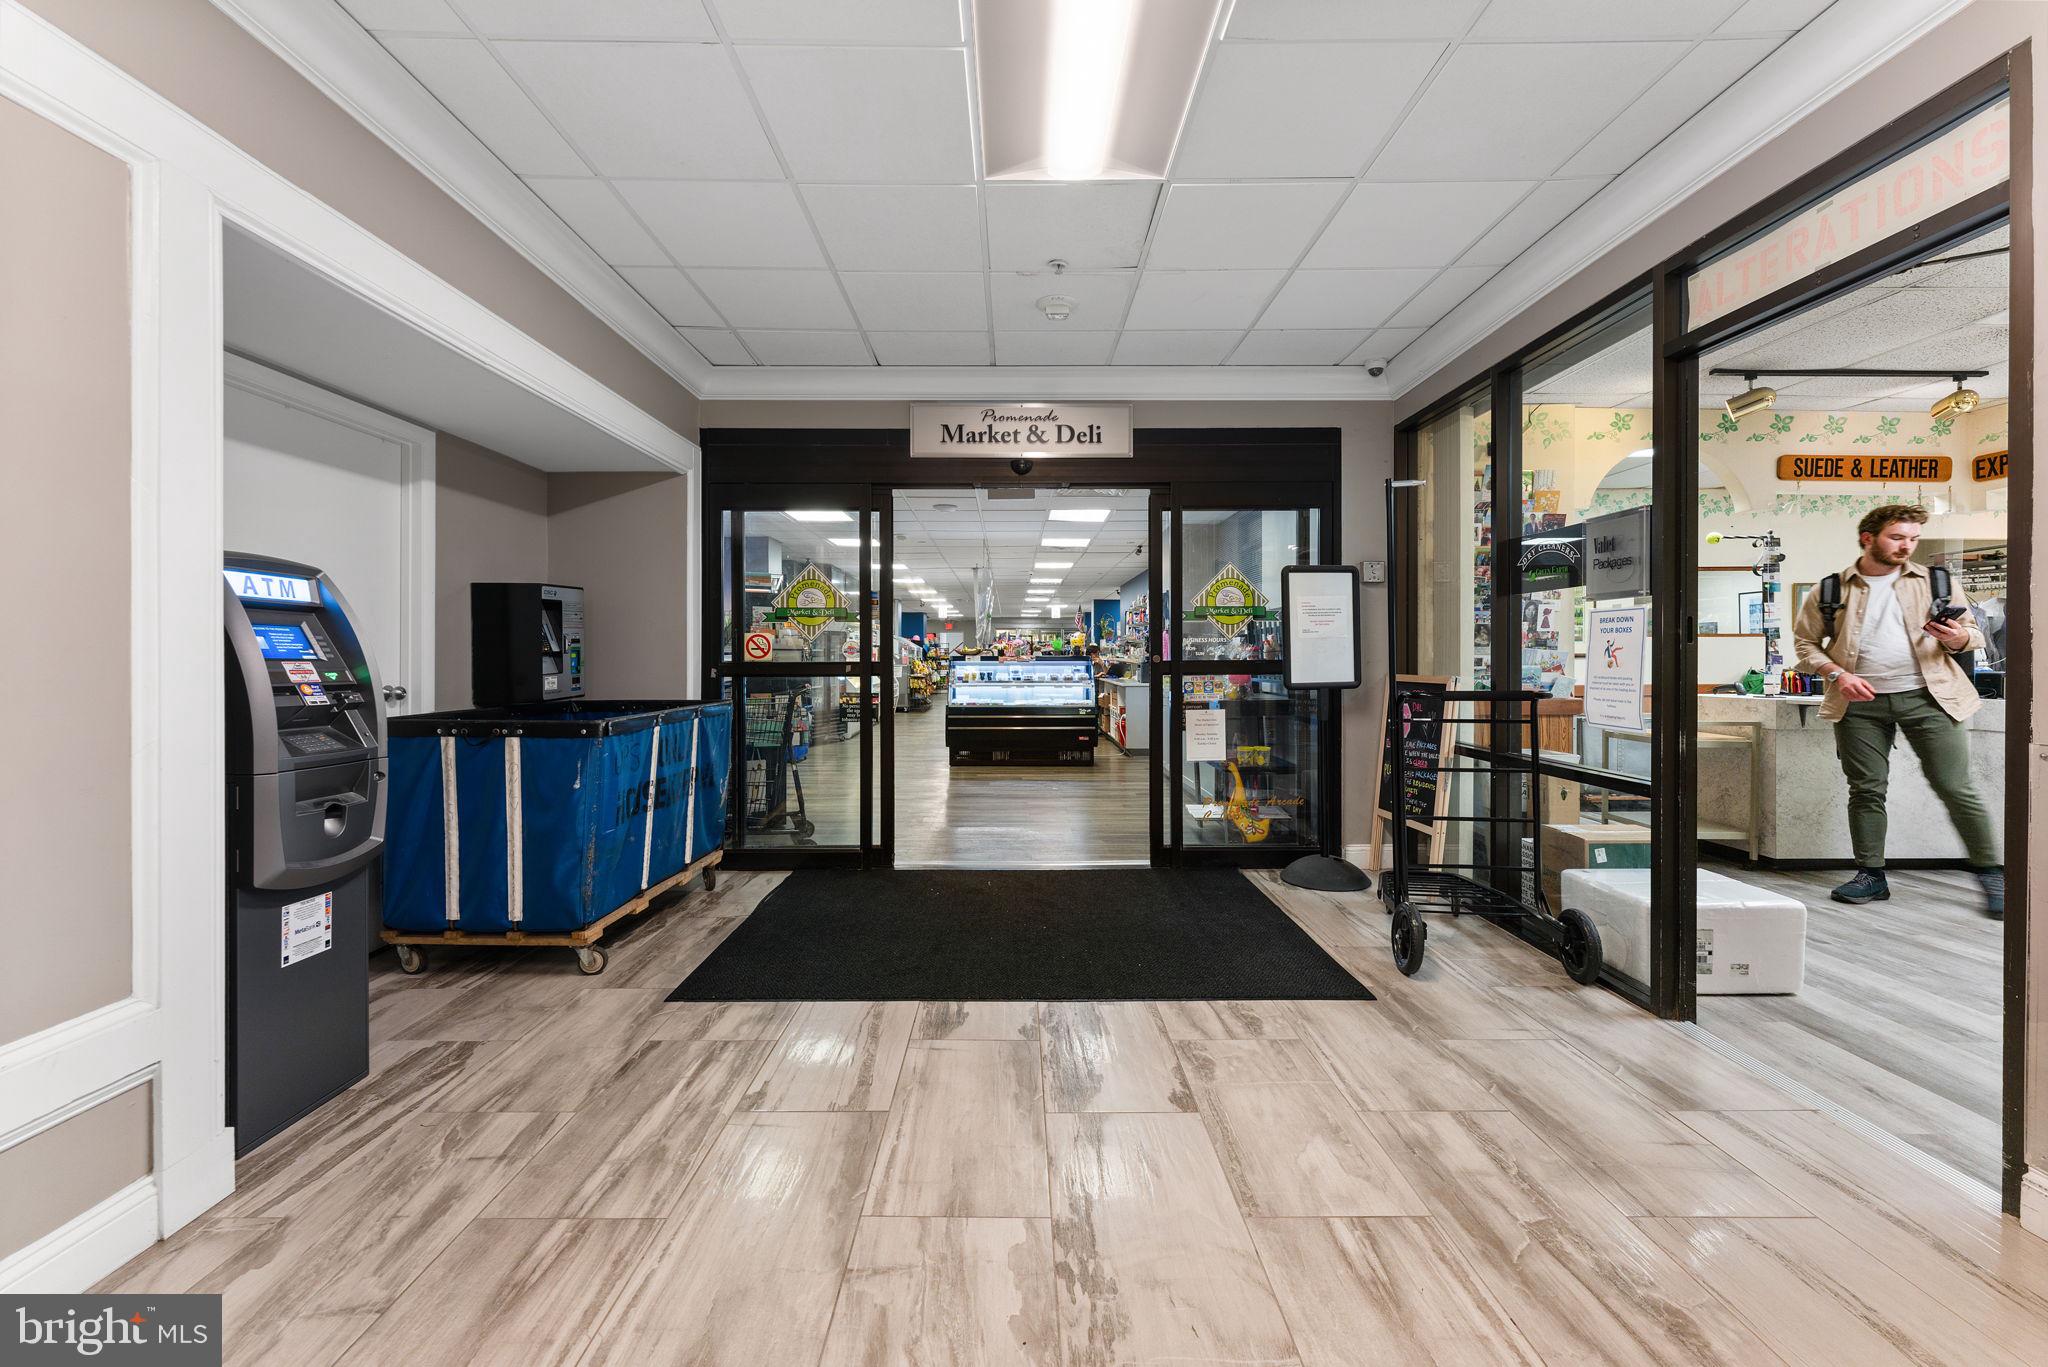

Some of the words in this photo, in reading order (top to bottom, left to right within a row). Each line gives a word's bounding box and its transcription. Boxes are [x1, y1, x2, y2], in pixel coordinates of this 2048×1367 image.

[1695, 117, 2009, 318] ALTERATIONS
[980, 408, 1059, 423] Promenade
[940, 423, 1020, 445] Market
[1026, 424, 1050, 445] &
[1055, 423, 1103, 445] Deli
[1794, 457, 1844, 478] SUEDE
[1851, 459, 1863, 478] &
[1870, 458, 1939, 479] LEATHER
[1522, 549, 1535, 565] DRY
[1538, 543, 1575, 558] CLEANERS
[1593, 536, 1616, 554] Valet
[1593, 555, 1633, 572] Packages
[243, 576, 296, 599] ATM
[789, 581, 832, 600] Promenade
[1208, 579, 1251, 599] Promenade
[787, 608, 811, 617] Market
[819, 608, 835, 617] Deli
[1206, 607, 1230, 616] Market
[1231, 607, 1238, 615] &
[1238, 607, 1253, 615] Deli
[1599, 616, 1615, 625] BREAK
[1616, 615, 1634, 624] DOWN
[1600, 626, 1614, 635] YOUR
[1615, 625, 1633, 634] BOXES
[1266, 793, 1306, 807] Arcade
